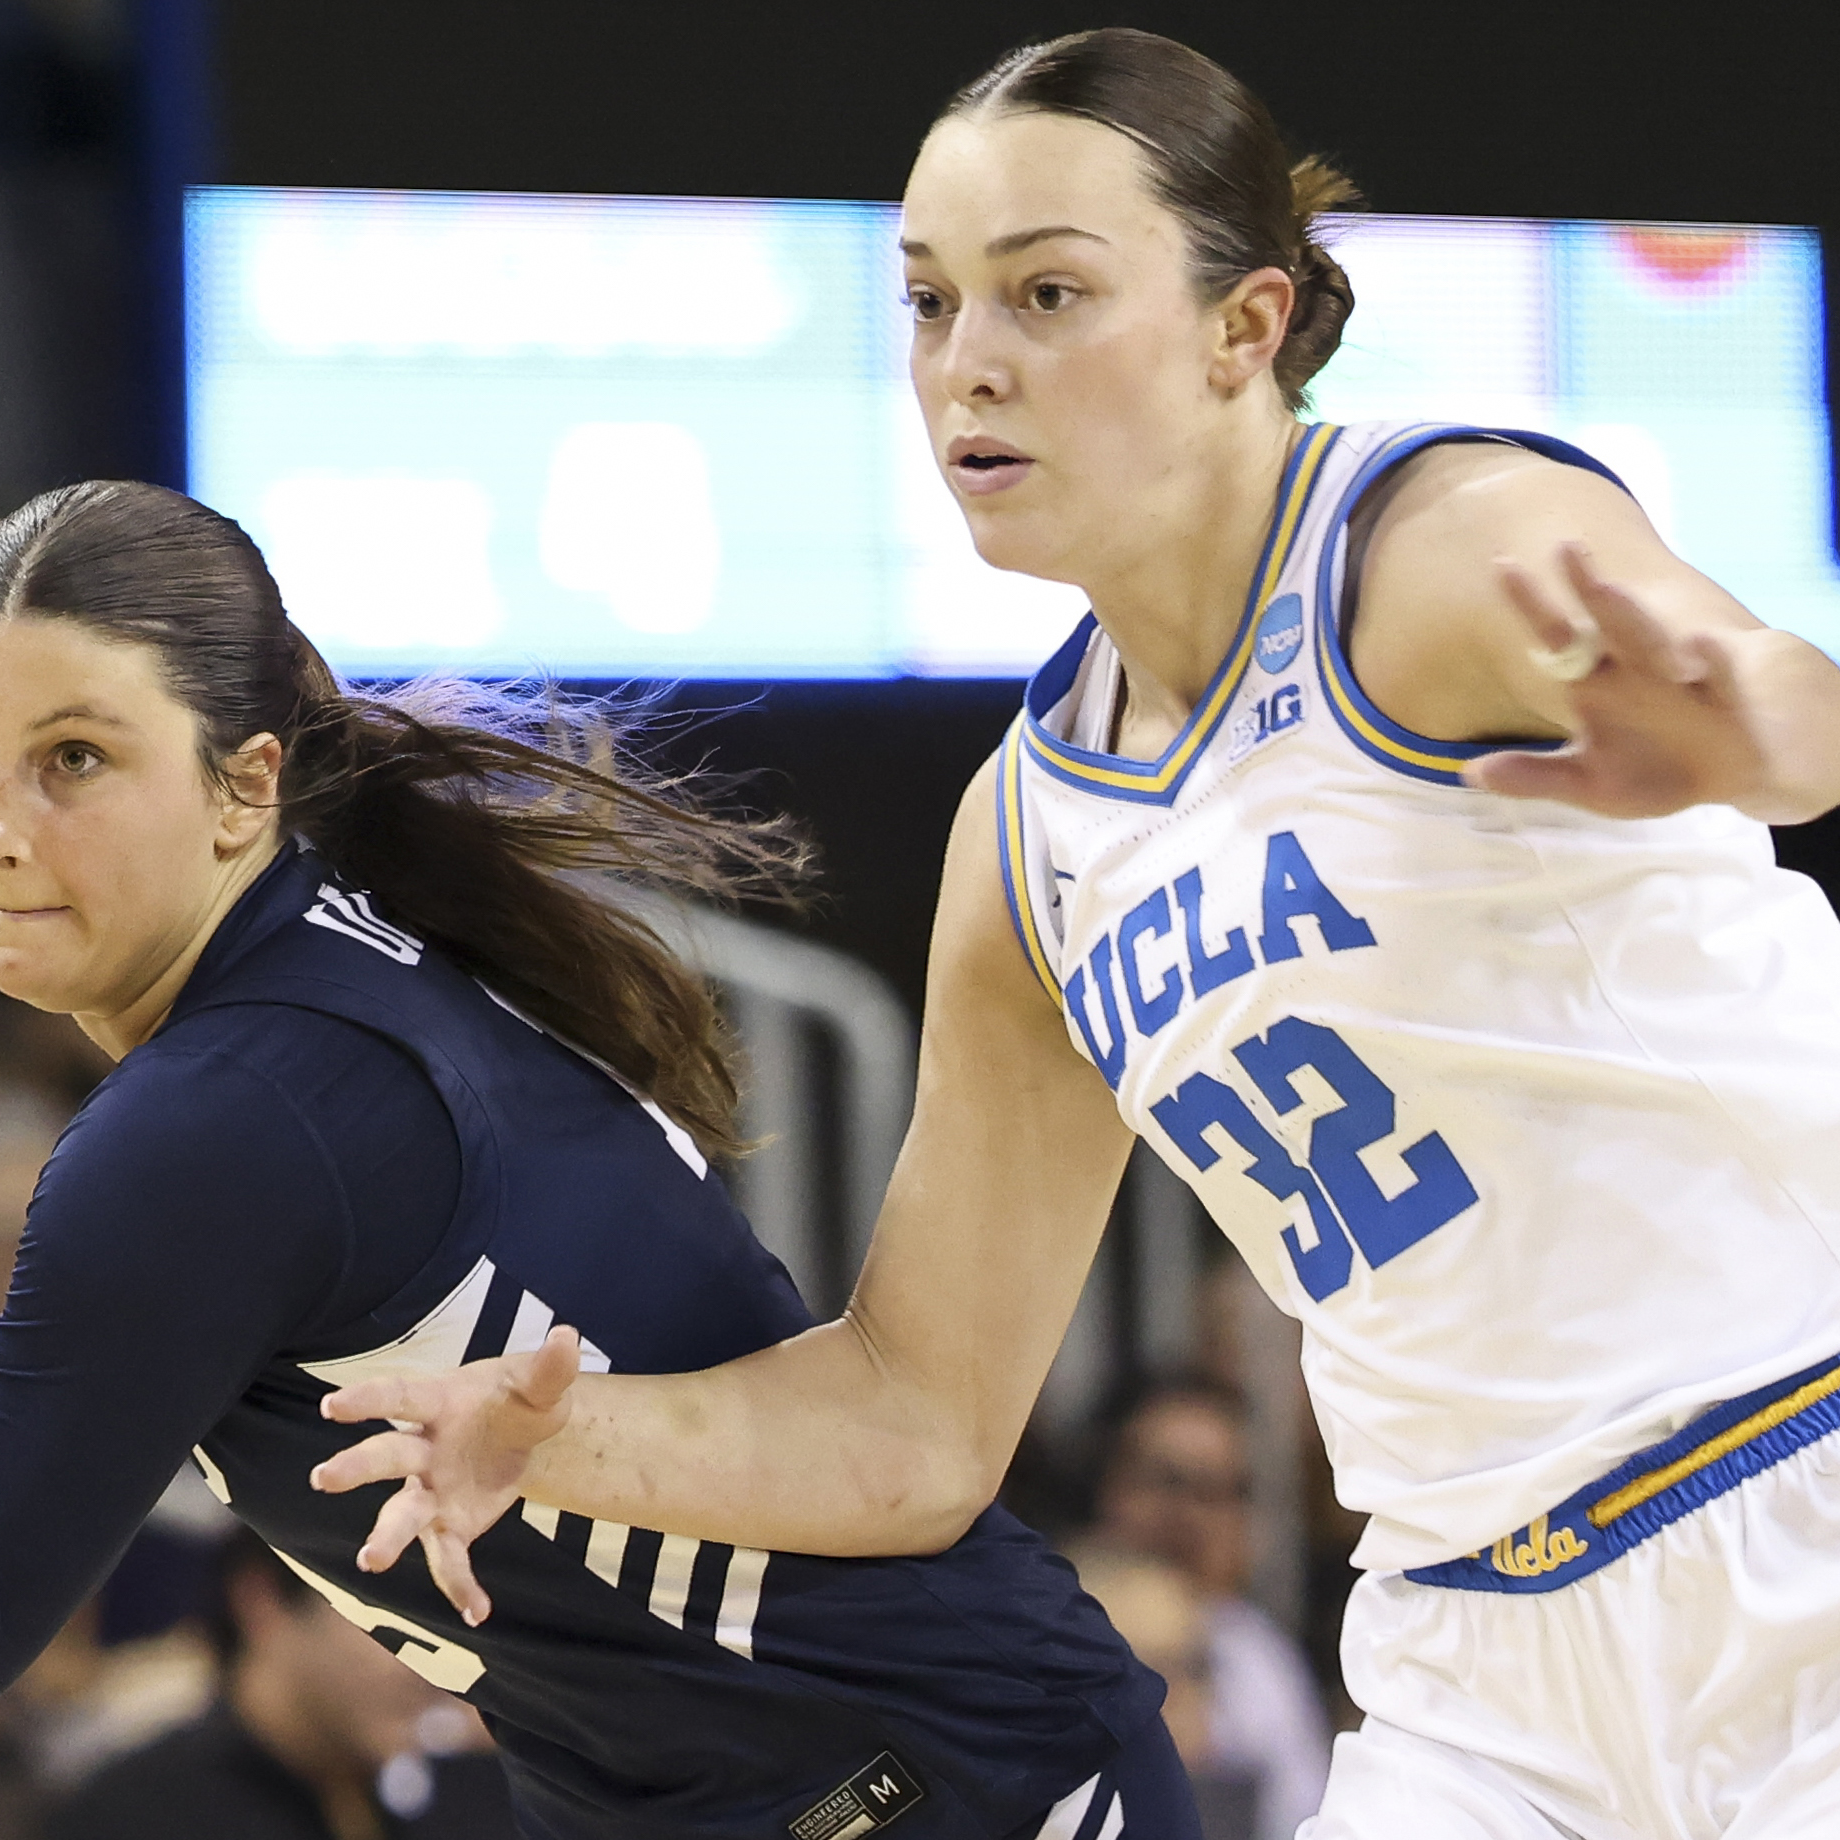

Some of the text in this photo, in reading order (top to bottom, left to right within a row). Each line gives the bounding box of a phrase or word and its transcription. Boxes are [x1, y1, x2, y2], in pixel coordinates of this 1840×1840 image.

[1064, 831, 1378, 1092] UCLA
[1148, 1014, 1480, 1304] 32
[868, 1773, 901, 1805] M
